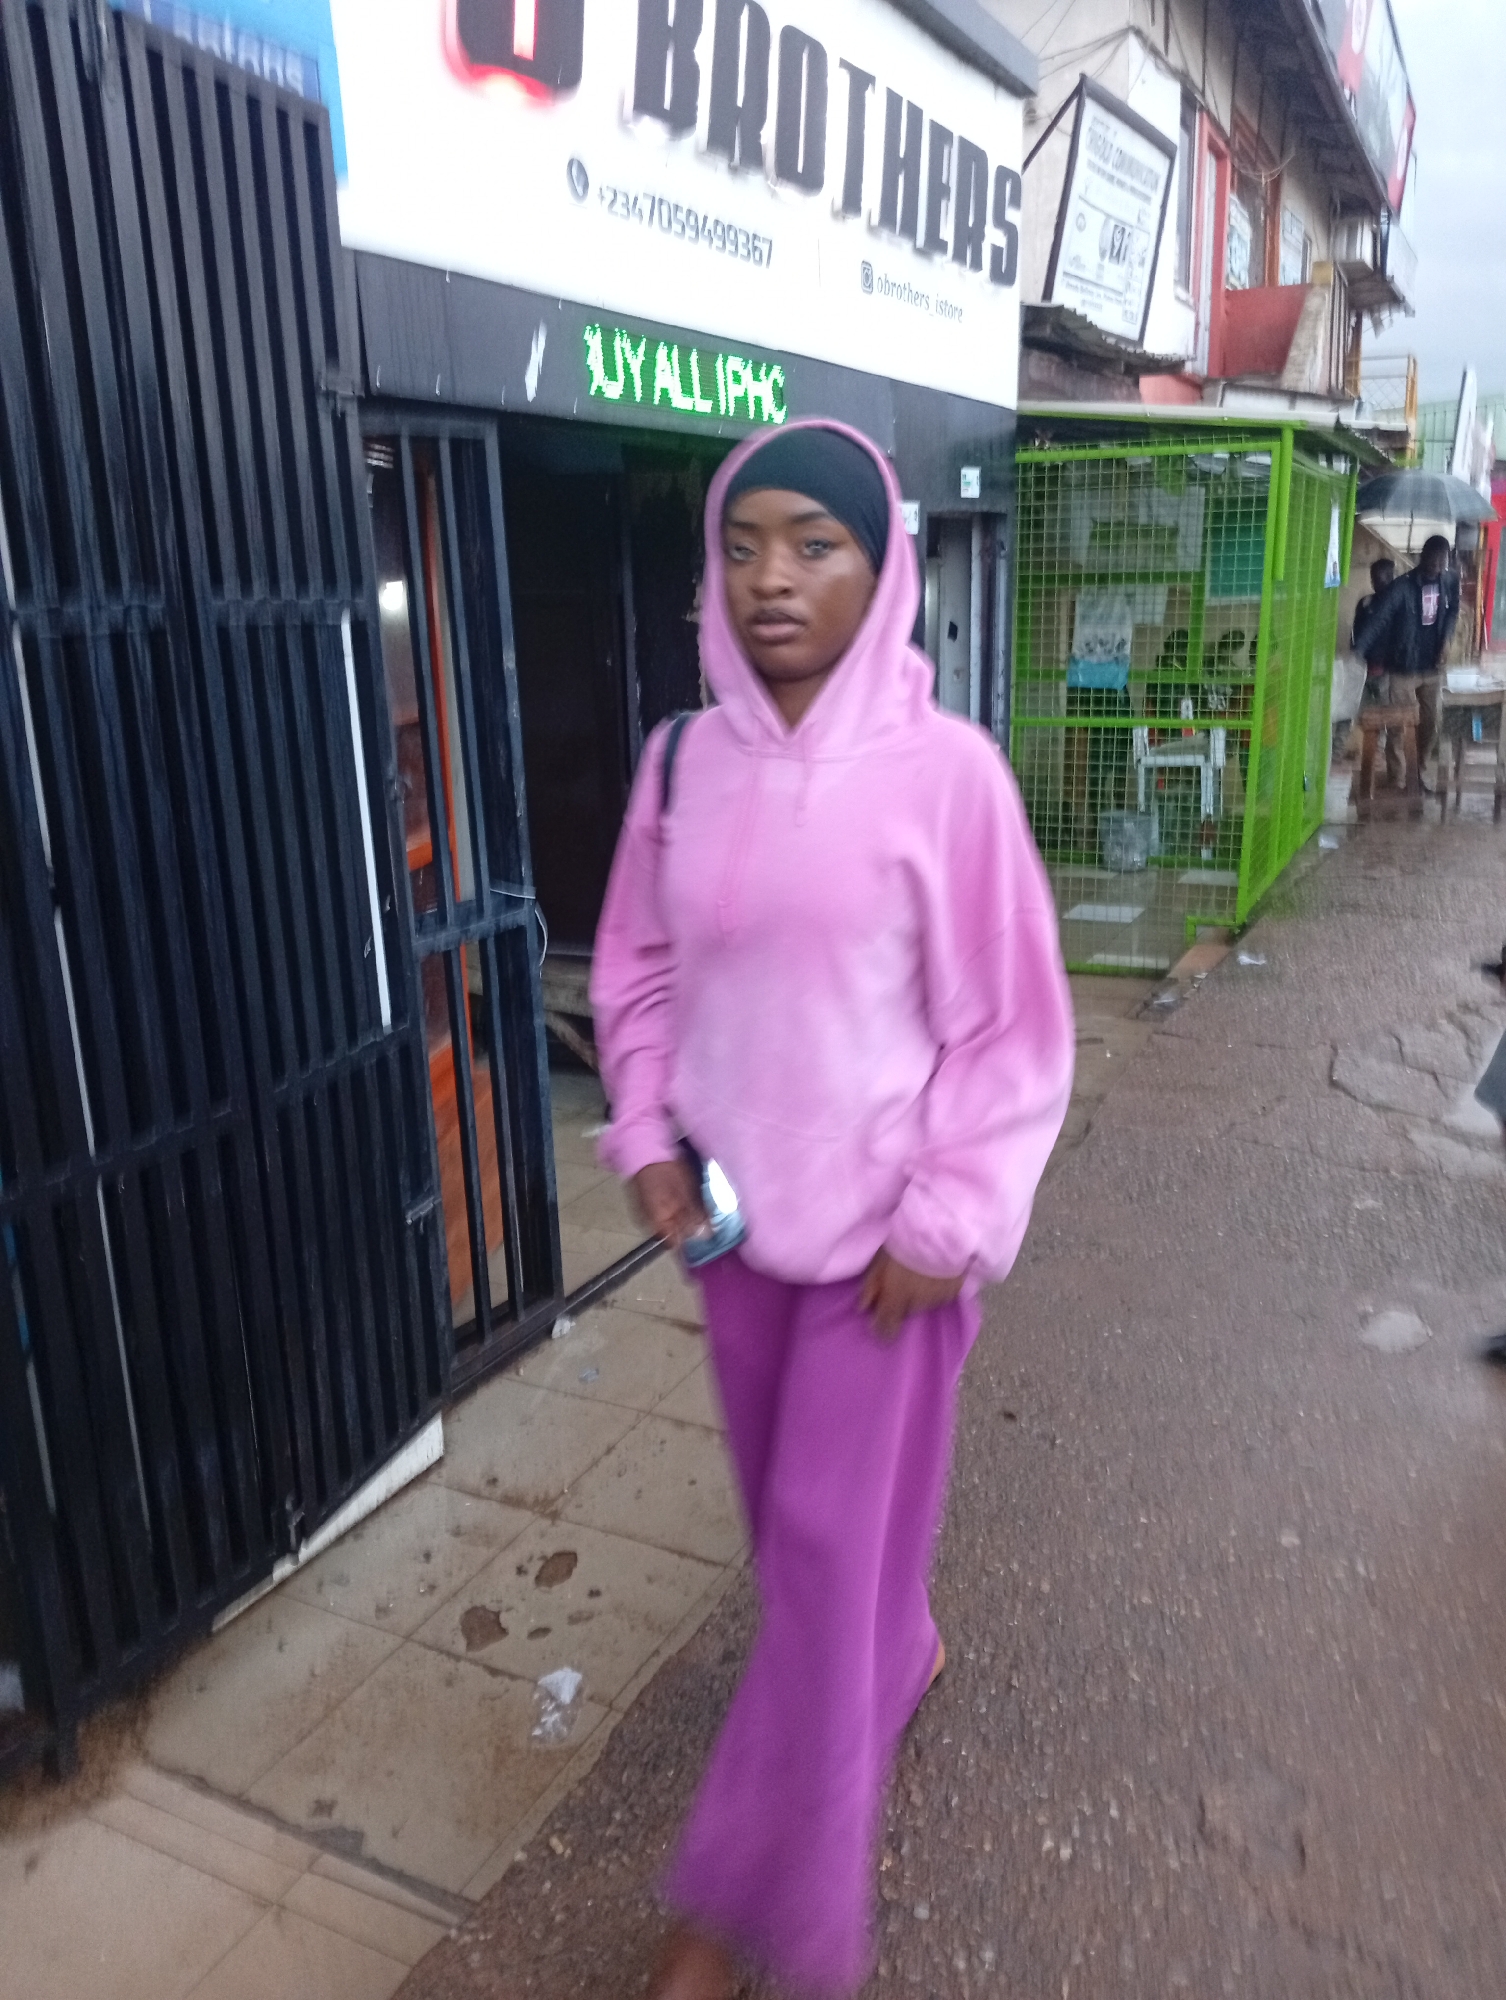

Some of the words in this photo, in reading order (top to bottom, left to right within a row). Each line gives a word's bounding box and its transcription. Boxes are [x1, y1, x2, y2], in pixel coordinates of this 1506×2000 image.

[632, 0, 1022, 288] BROTHERS
[598, 186, 773, 269] +2347059499367
[876, 272, 963, 323] obrothers_istore
[653, 341, 713, 413] ALL
